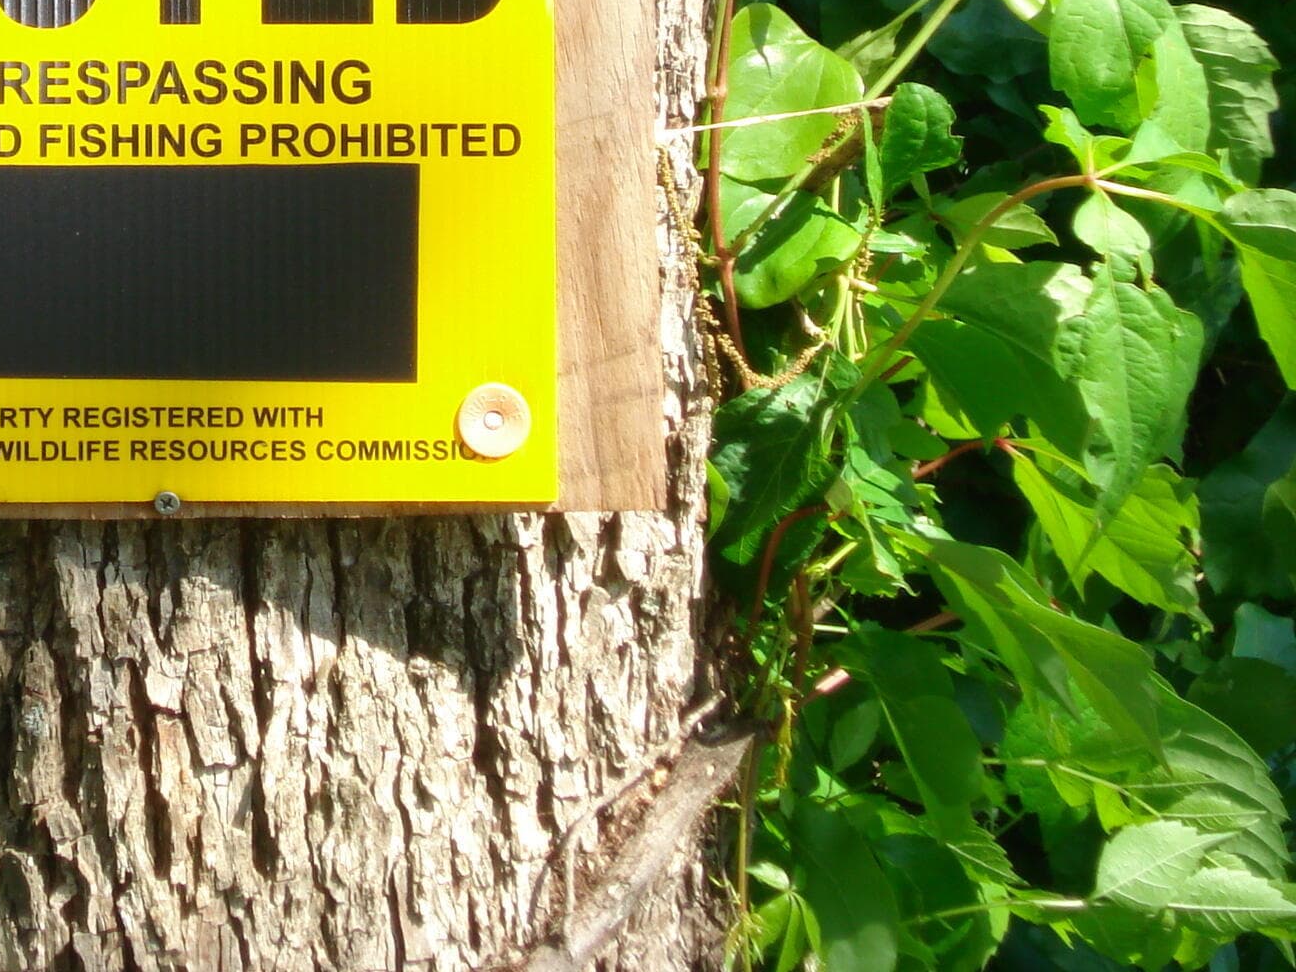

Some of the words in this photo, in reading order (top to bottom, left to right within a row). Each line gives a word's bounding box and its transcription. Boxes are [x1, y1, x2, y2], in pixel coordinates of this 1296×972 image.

[40, 124, 222, 158] FISHING
[239, 123, 521, 158] PROHIBITED
[63, 406, 244, 429] REGISTERED
[253, 406, 323, 428] WITH
[130, 439, 306, 462] RESOURCES
[316, 439, 495, 462] COMMISSIO
